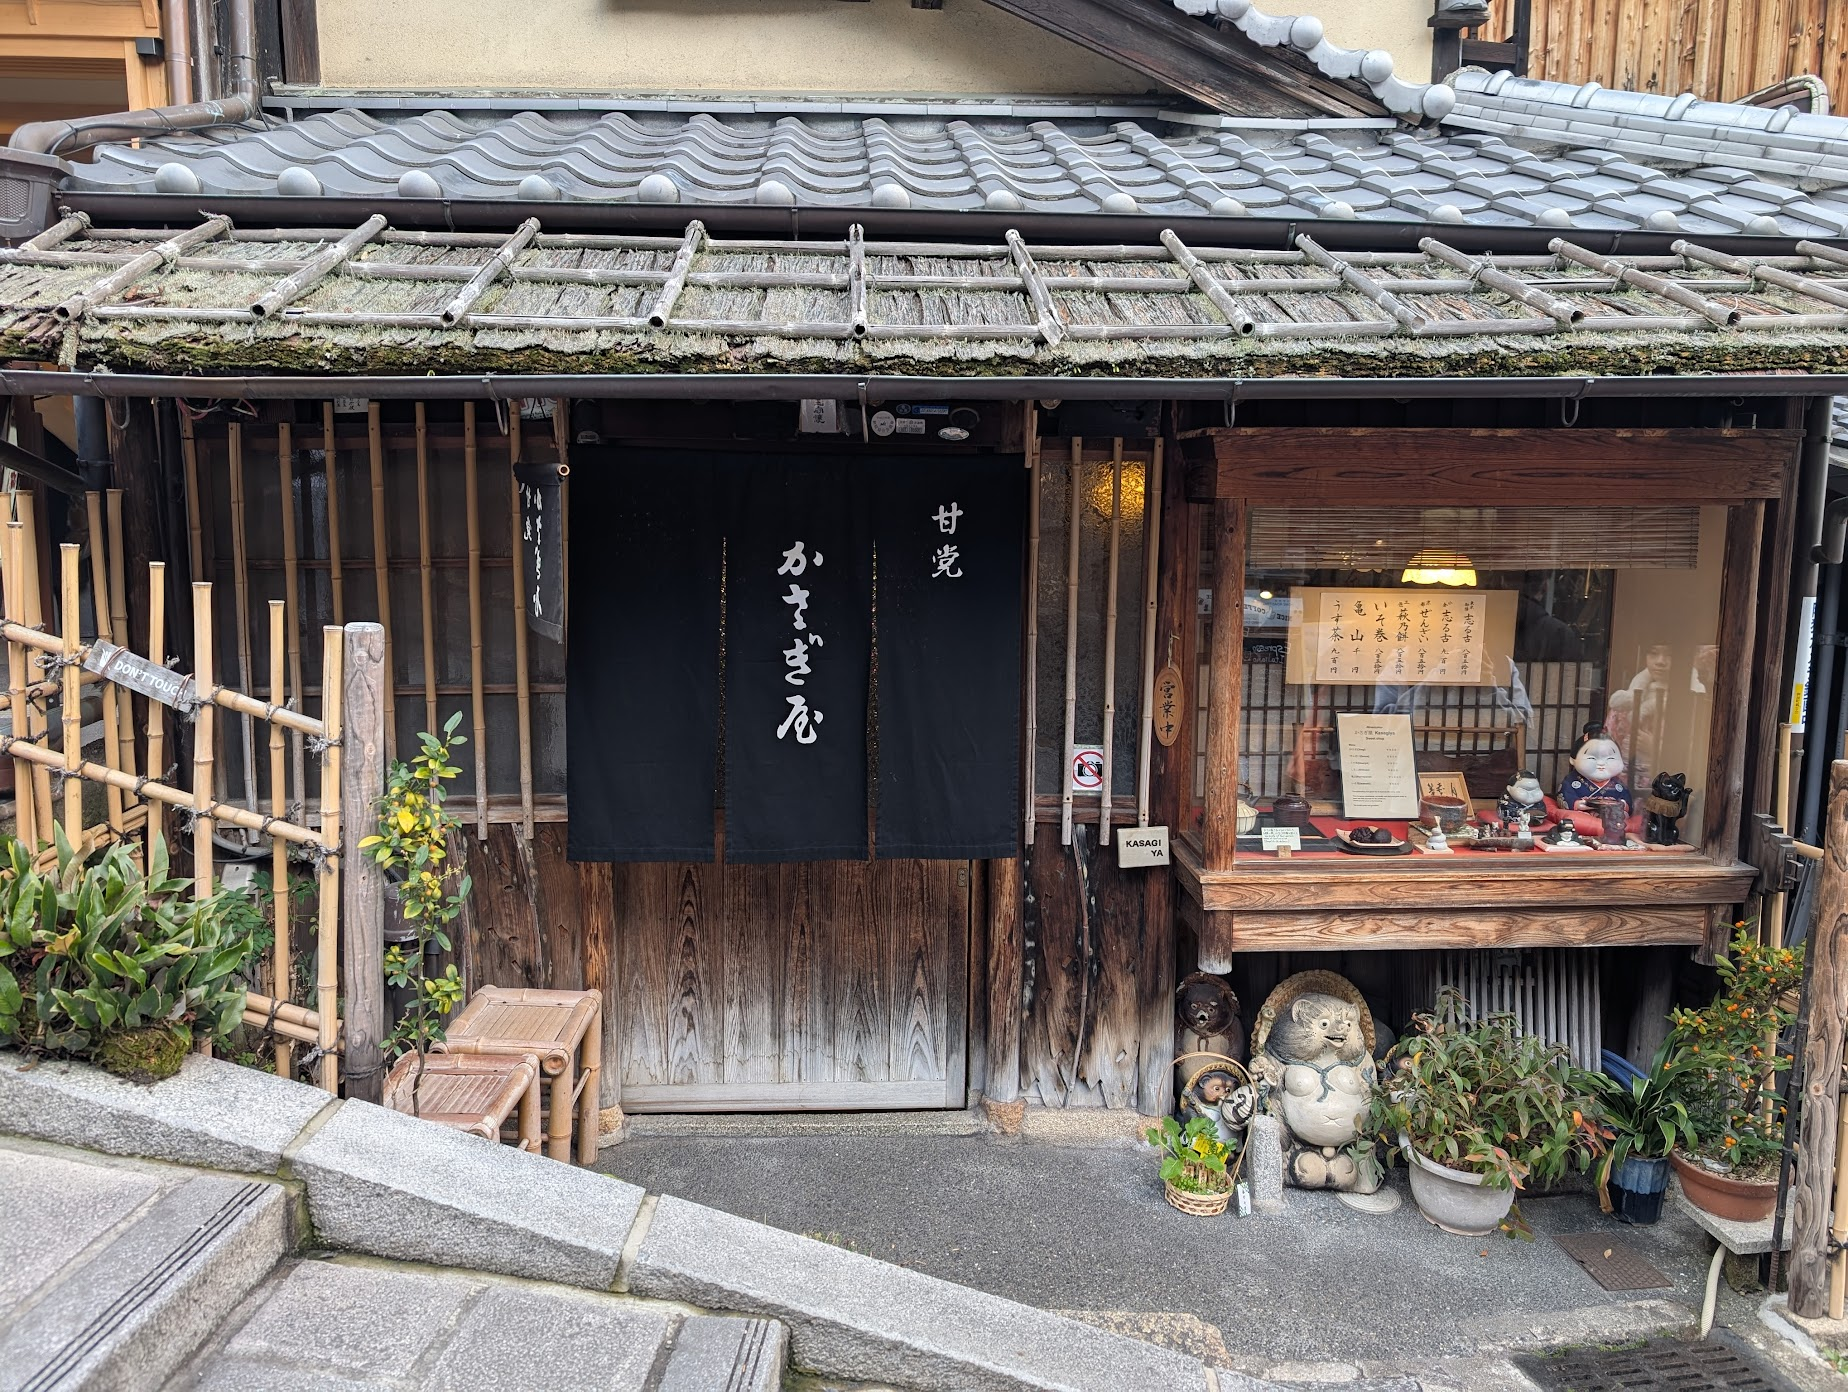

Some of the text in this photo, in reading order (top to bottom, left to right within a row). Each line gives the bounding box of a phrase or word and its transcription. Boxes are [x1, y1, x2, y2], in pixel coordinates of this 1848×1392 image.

[931, 501, 964, 578] 甘党
[776, 540, 825, 745] かさぎ屋
[1328, 599, 1344, 674] うす茶 九百円
[1350, 600, 1367, 674] 亀山 千円
[1374, 601, 1389, 643] いそ巻
[1418, 608, 1433, 643] ぜんざい
[114, 660, 150, 682] DON'T
[1159, 681, 1176, 739] 営業中
[1125, 839, 1162, 848] KASAGI
[1150, 849, 1164, 857] YA
